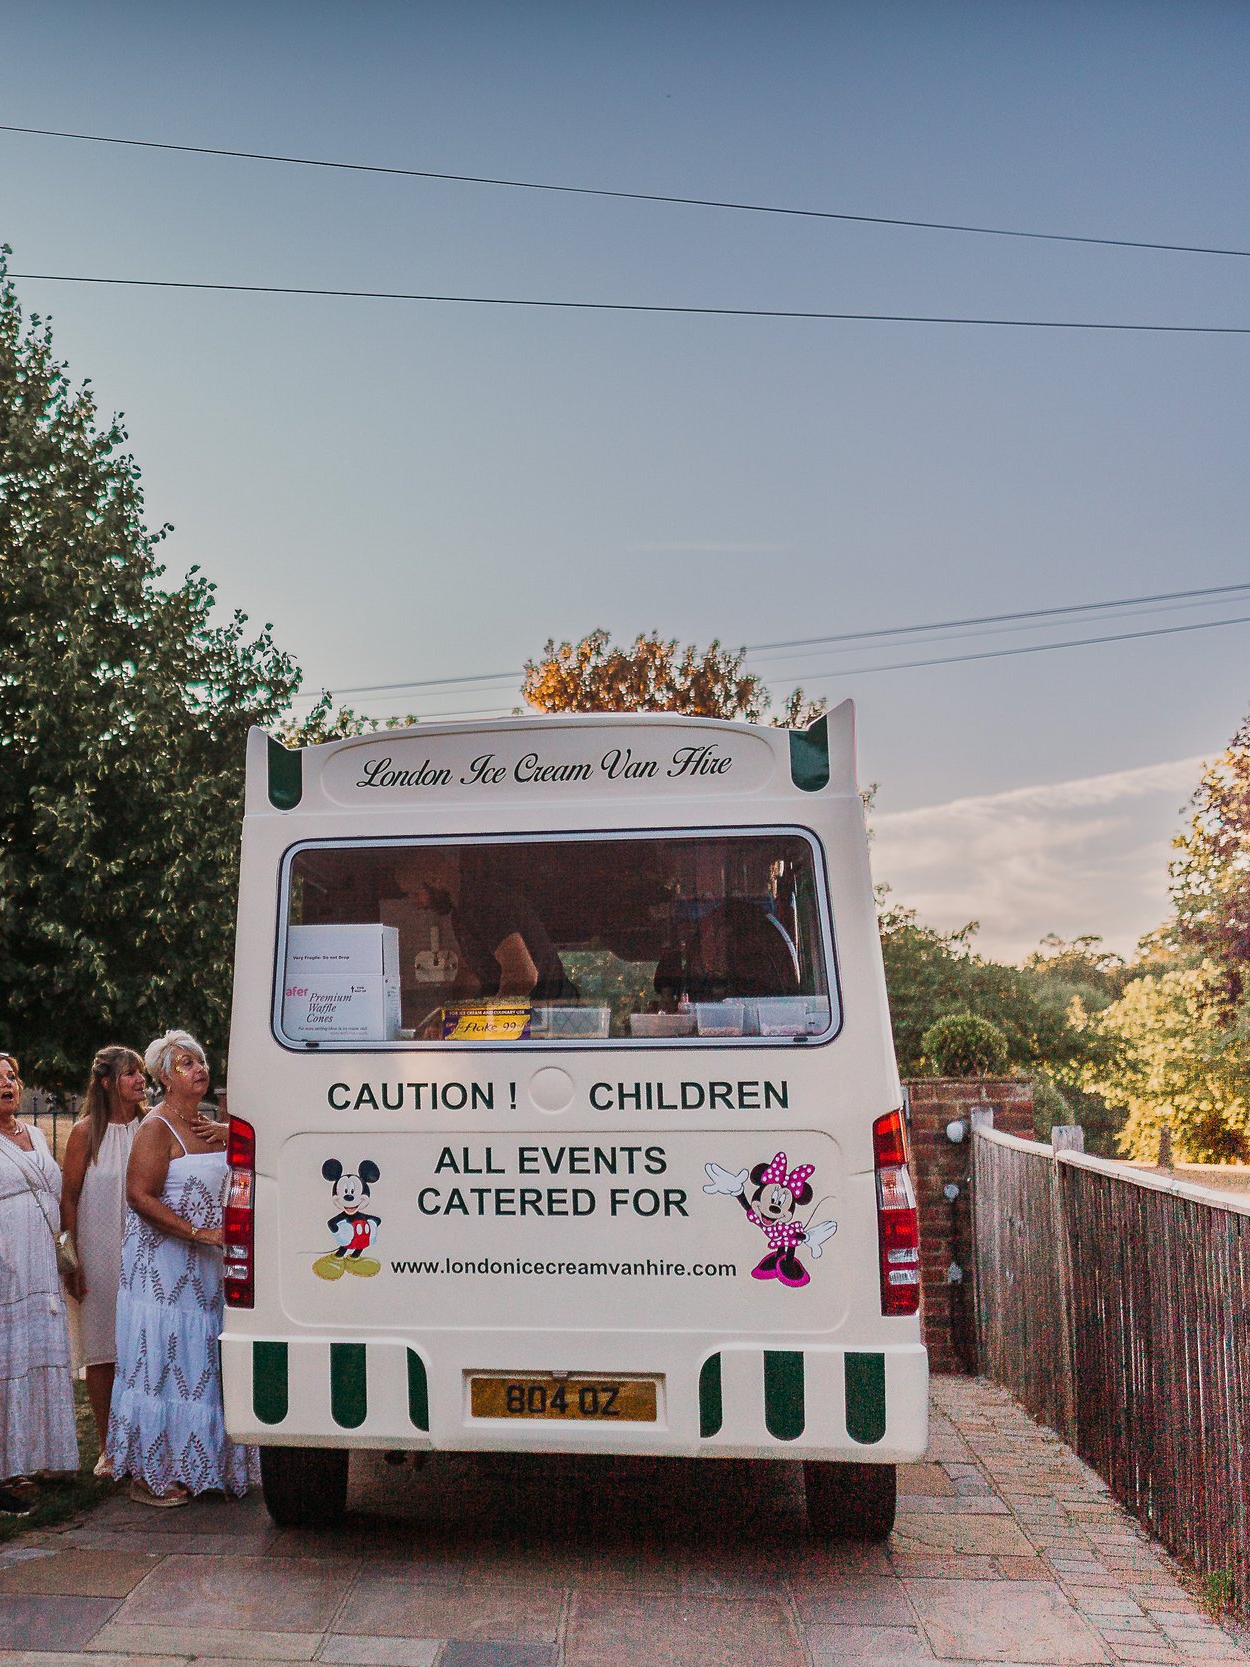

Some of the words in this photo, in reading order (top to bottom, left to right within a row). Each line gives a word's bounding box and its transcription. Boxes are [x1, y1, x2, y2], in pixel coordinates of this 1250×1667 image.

[355, 757, 454, 788] London
[459, 753, 507, 785] Ice
[513, 752, 594, 783] Cream
[600, 748, 660, 780] Van
[666, 743, 733, 778] Hire
[308, 1003, 337, 1015] Waffle
[309, 992, 352, 1002] Premium
[306, 1013, 334, 1023] Cones
[327, 1082, 494, 1111] CAUTION
[589, 1080, 789, 1111] CHILDREN
[433, 1146, 506, 1174] ALL
[518, 1146, 667, 1175] EVENTS
[417, 1187, 596, 1217] CATERED
[610, 1188, 690, 1217] FOR
[390, 1257, 737, 1277] www.londonicecreamvanhire.com
[506, 1384, 569, 1414] 804
